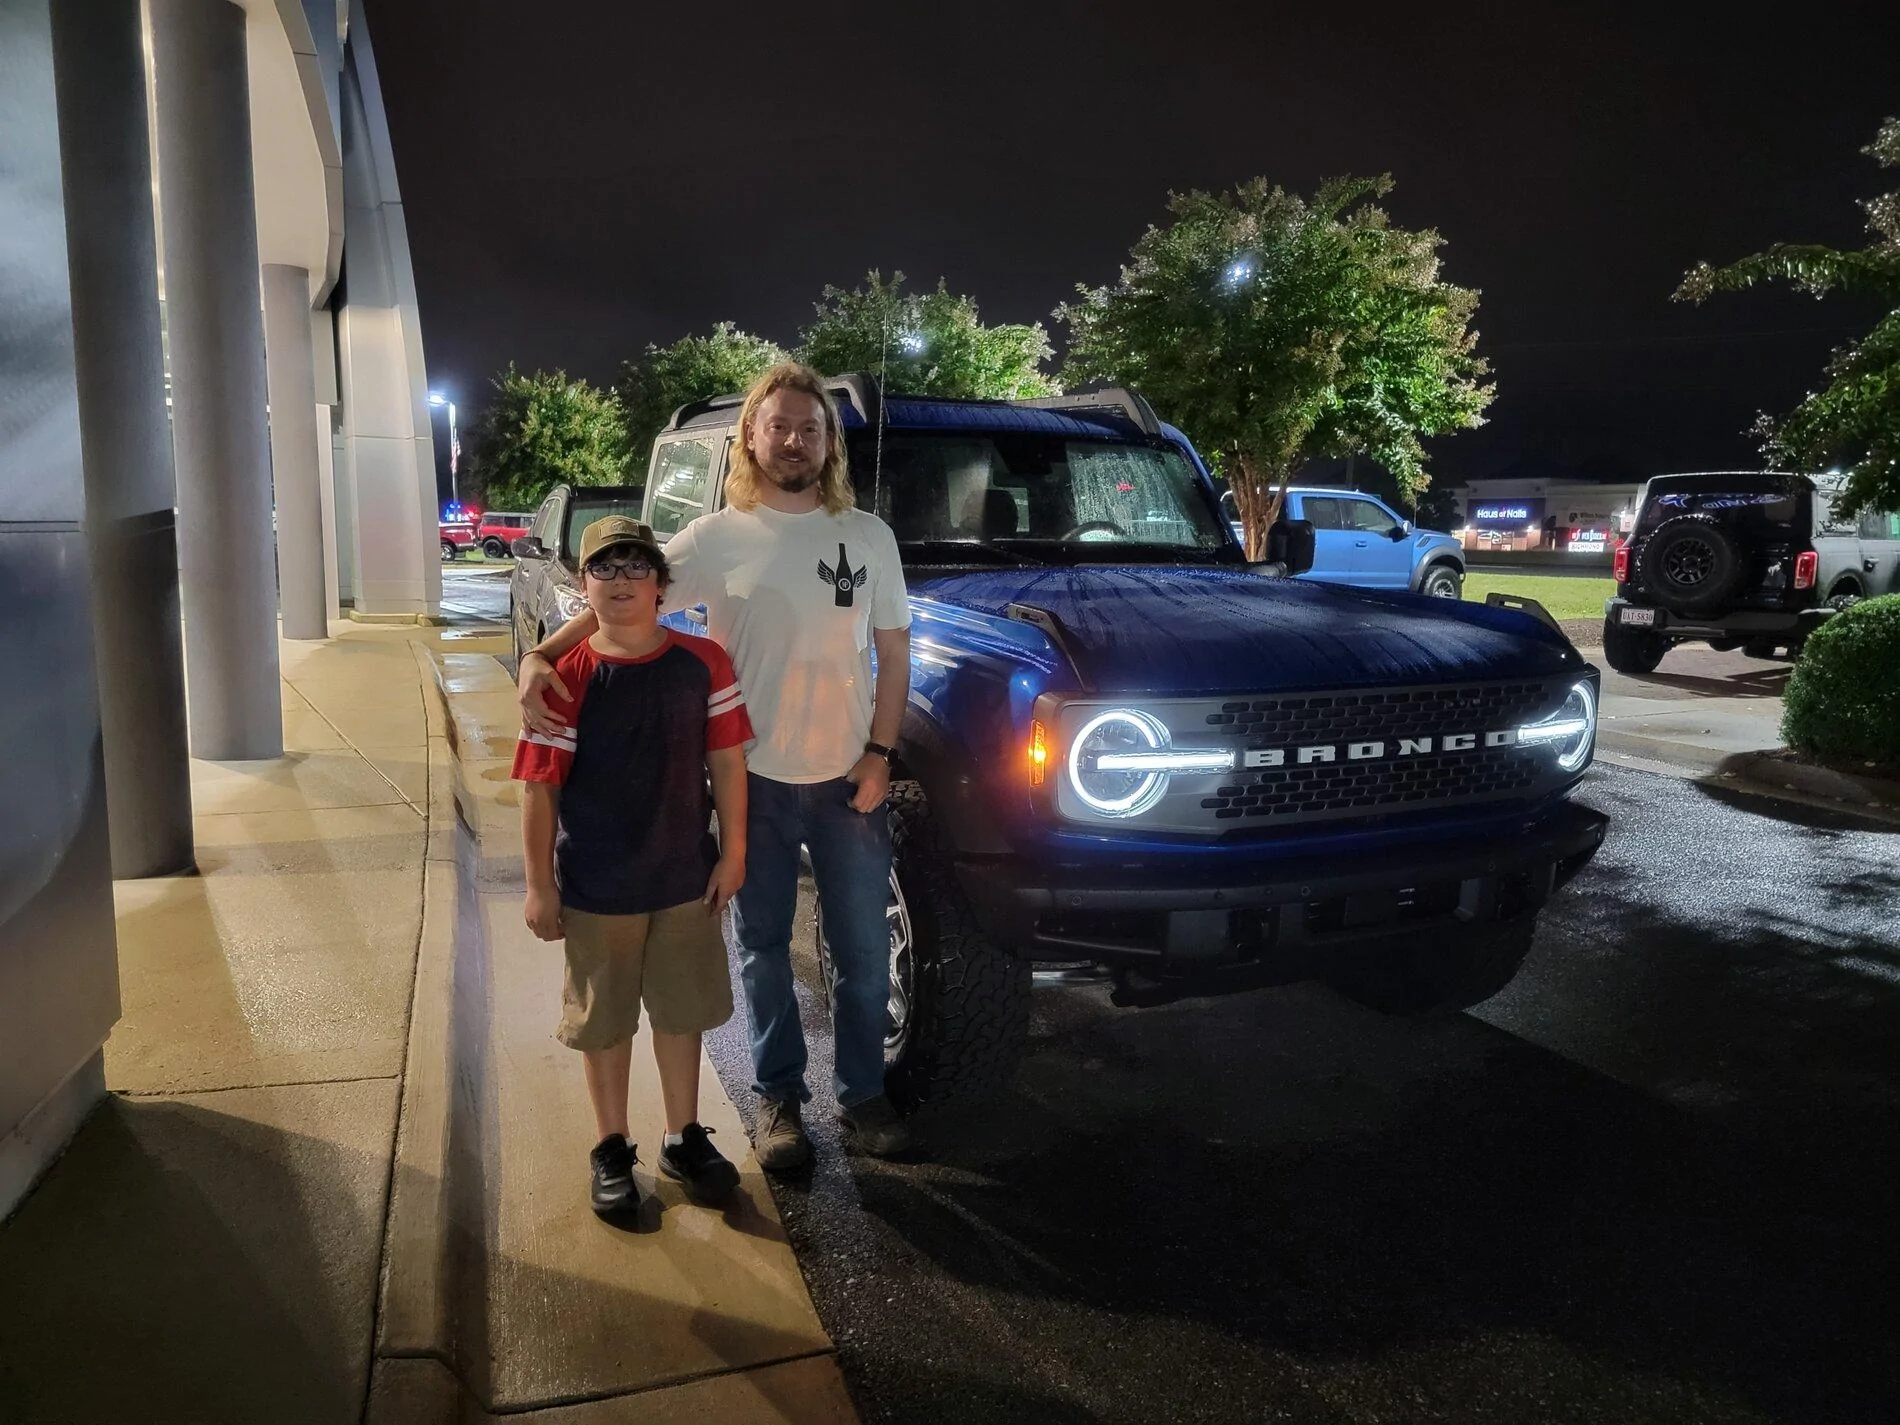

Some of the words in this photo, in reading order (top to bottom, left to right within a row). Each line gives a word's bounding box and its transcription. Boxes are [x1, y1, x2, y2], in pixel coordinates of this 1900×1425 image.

[1477, 509, 1498, 518] Haus
[1506, 508, 1527, 518] Nails
[1244, 730, 1518, 768] BRONCO
